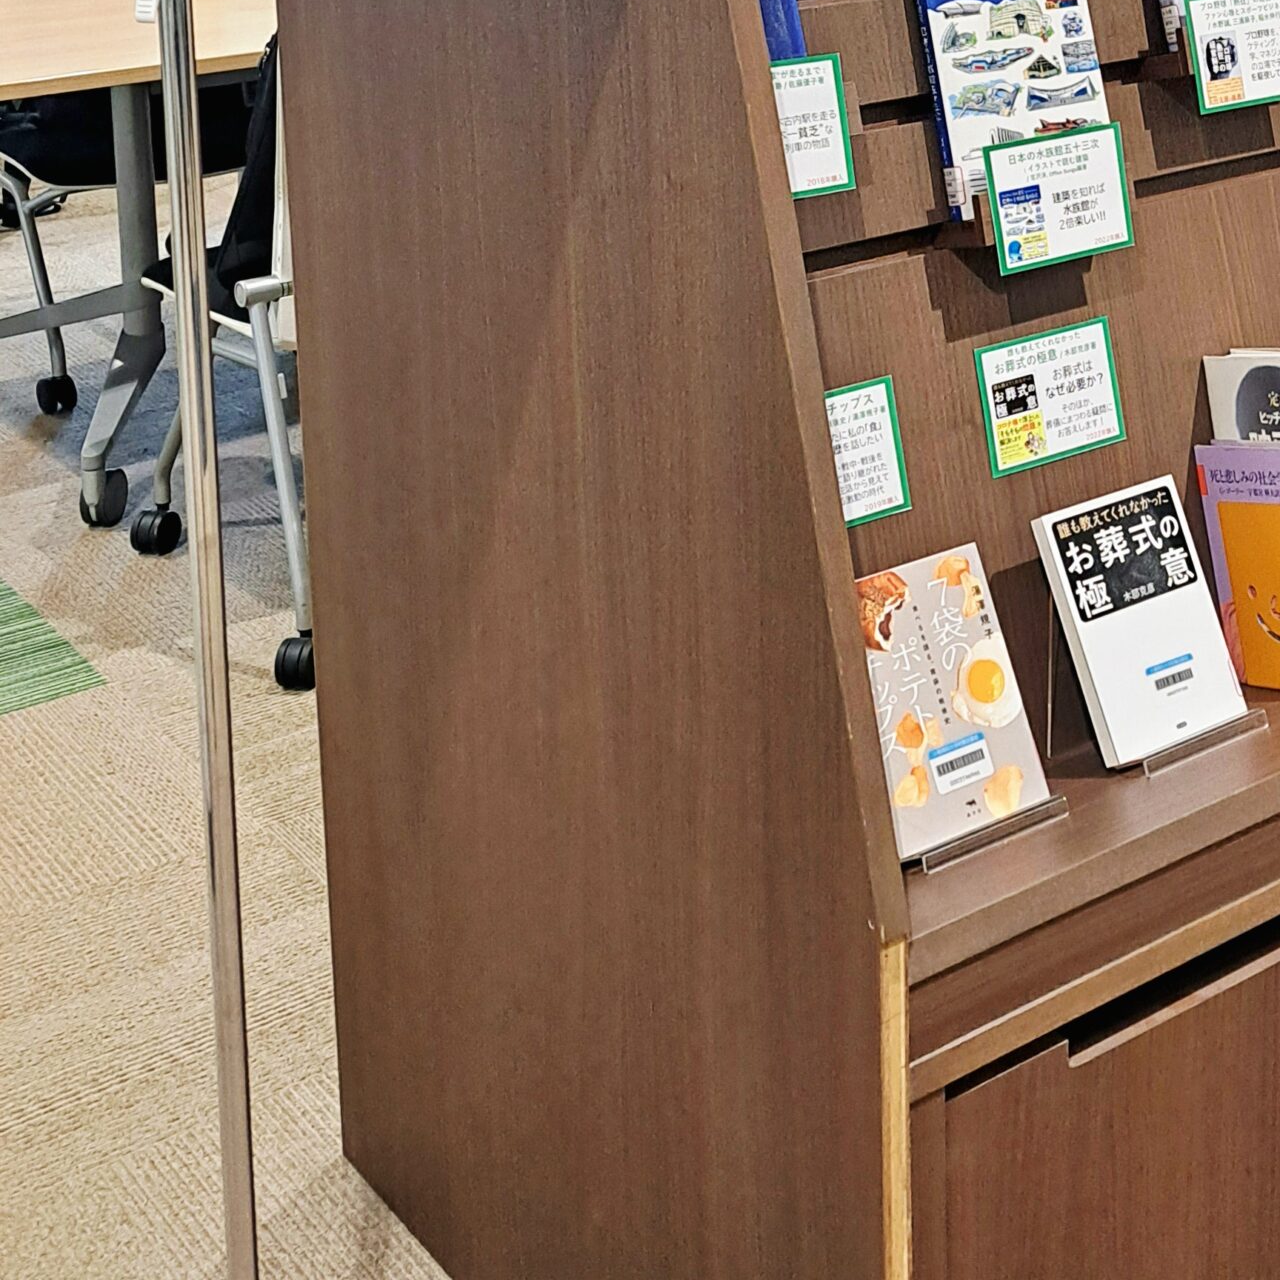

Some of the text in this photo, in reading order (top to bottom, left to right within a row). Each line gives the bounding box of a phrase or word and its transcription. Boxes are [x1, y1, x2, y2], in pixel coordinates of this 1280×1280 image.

[1007, 139, 1100, 165] 日本の水族館五十三次
[1052, 182, 1106, 204] 建築を知れば
[1063, 197, 1099, 216] 水族館が
[994, 348, 1058, 375] お葬式の極意
[1052, 360, 1093, 381] お葬式は
[1045, 372, 1105, 400] なぜ必要か？
[1057, 490, 1169, 540] 誰も教えてくれなかった
[1066, 513, 1179, 576] お葬式の
[1075, 547, 1194, 620] 極 意
[927, 577, 972, 671] 7袋の
[892, 636, 933, 734] ポテト
